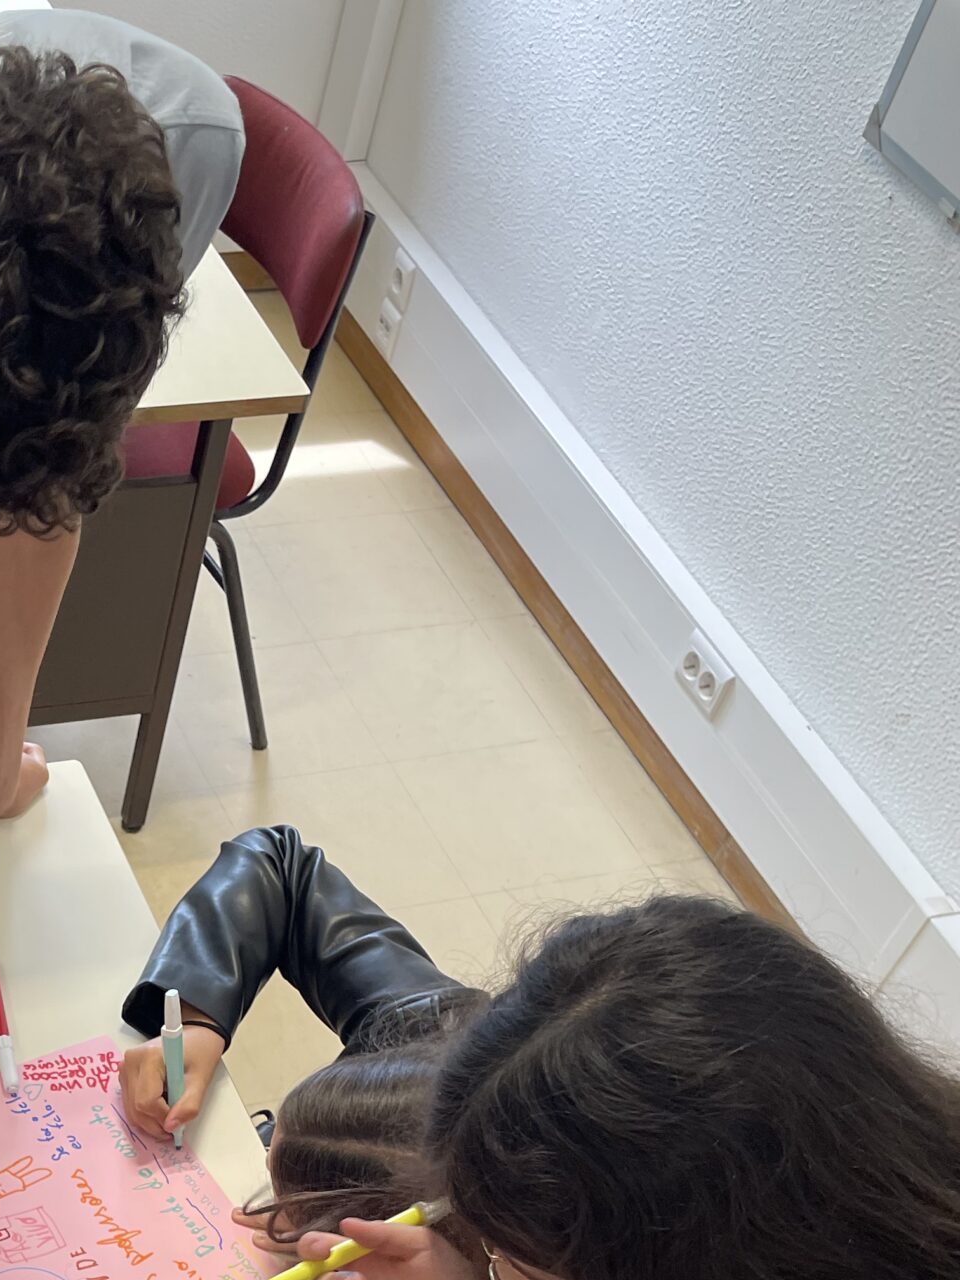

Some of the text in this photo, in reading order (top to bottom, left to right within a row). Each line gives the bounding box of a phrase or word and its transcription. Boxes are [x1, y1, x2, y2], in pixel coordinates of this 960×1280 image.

[97, 1051, 115, 1062] de
[50, 1079, 83, 1093] vivo
[133, 1167, 163, 1190] do
[71, 1168, 154, 1266] professores
[160, 1196, 216, 1258] Depende
